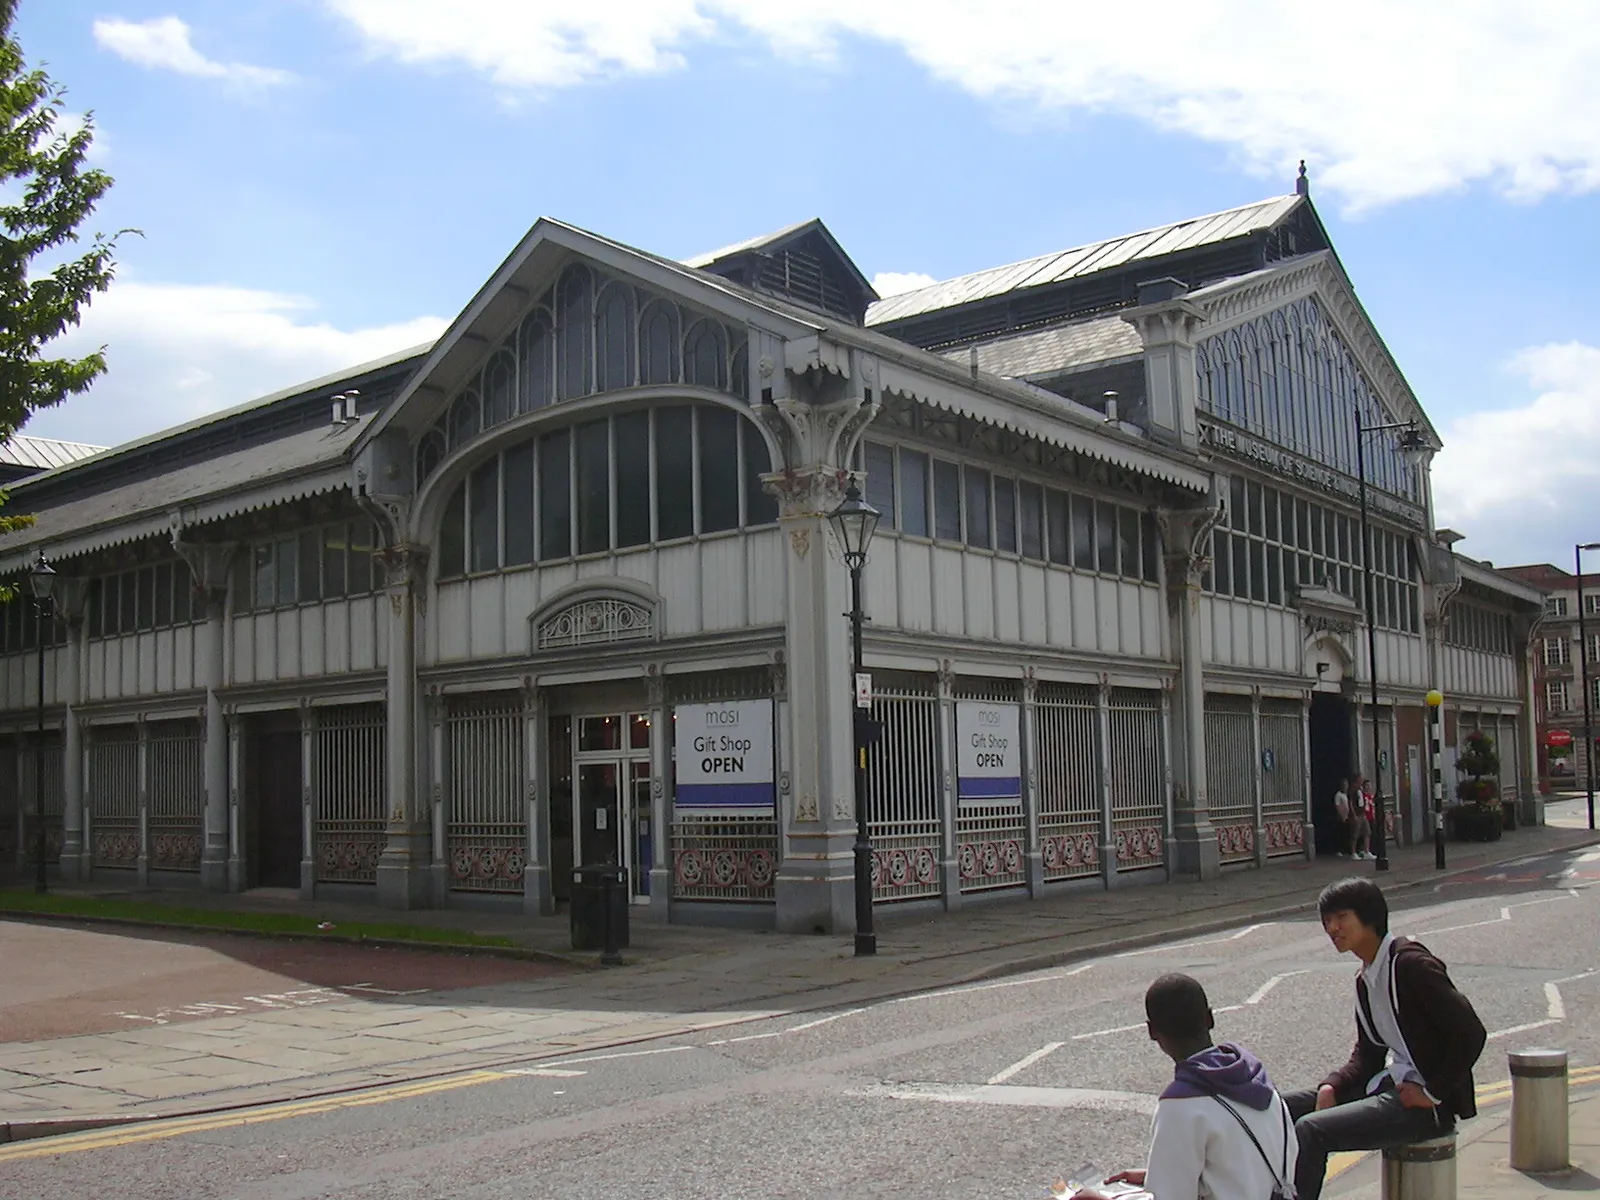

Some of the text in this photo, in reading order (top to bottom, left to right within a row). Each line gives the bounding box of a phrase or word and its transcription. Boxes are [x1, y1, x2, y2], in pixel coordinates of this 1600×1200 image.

[1212, 425, 1236, 449] THE
[693, 735, 752, 755] Gift Shop
[971, 733, 1008, 752] Gift Shop
[701, 757, 744, 773] OPEN
[976, 753, 1005, 768] OPEN
